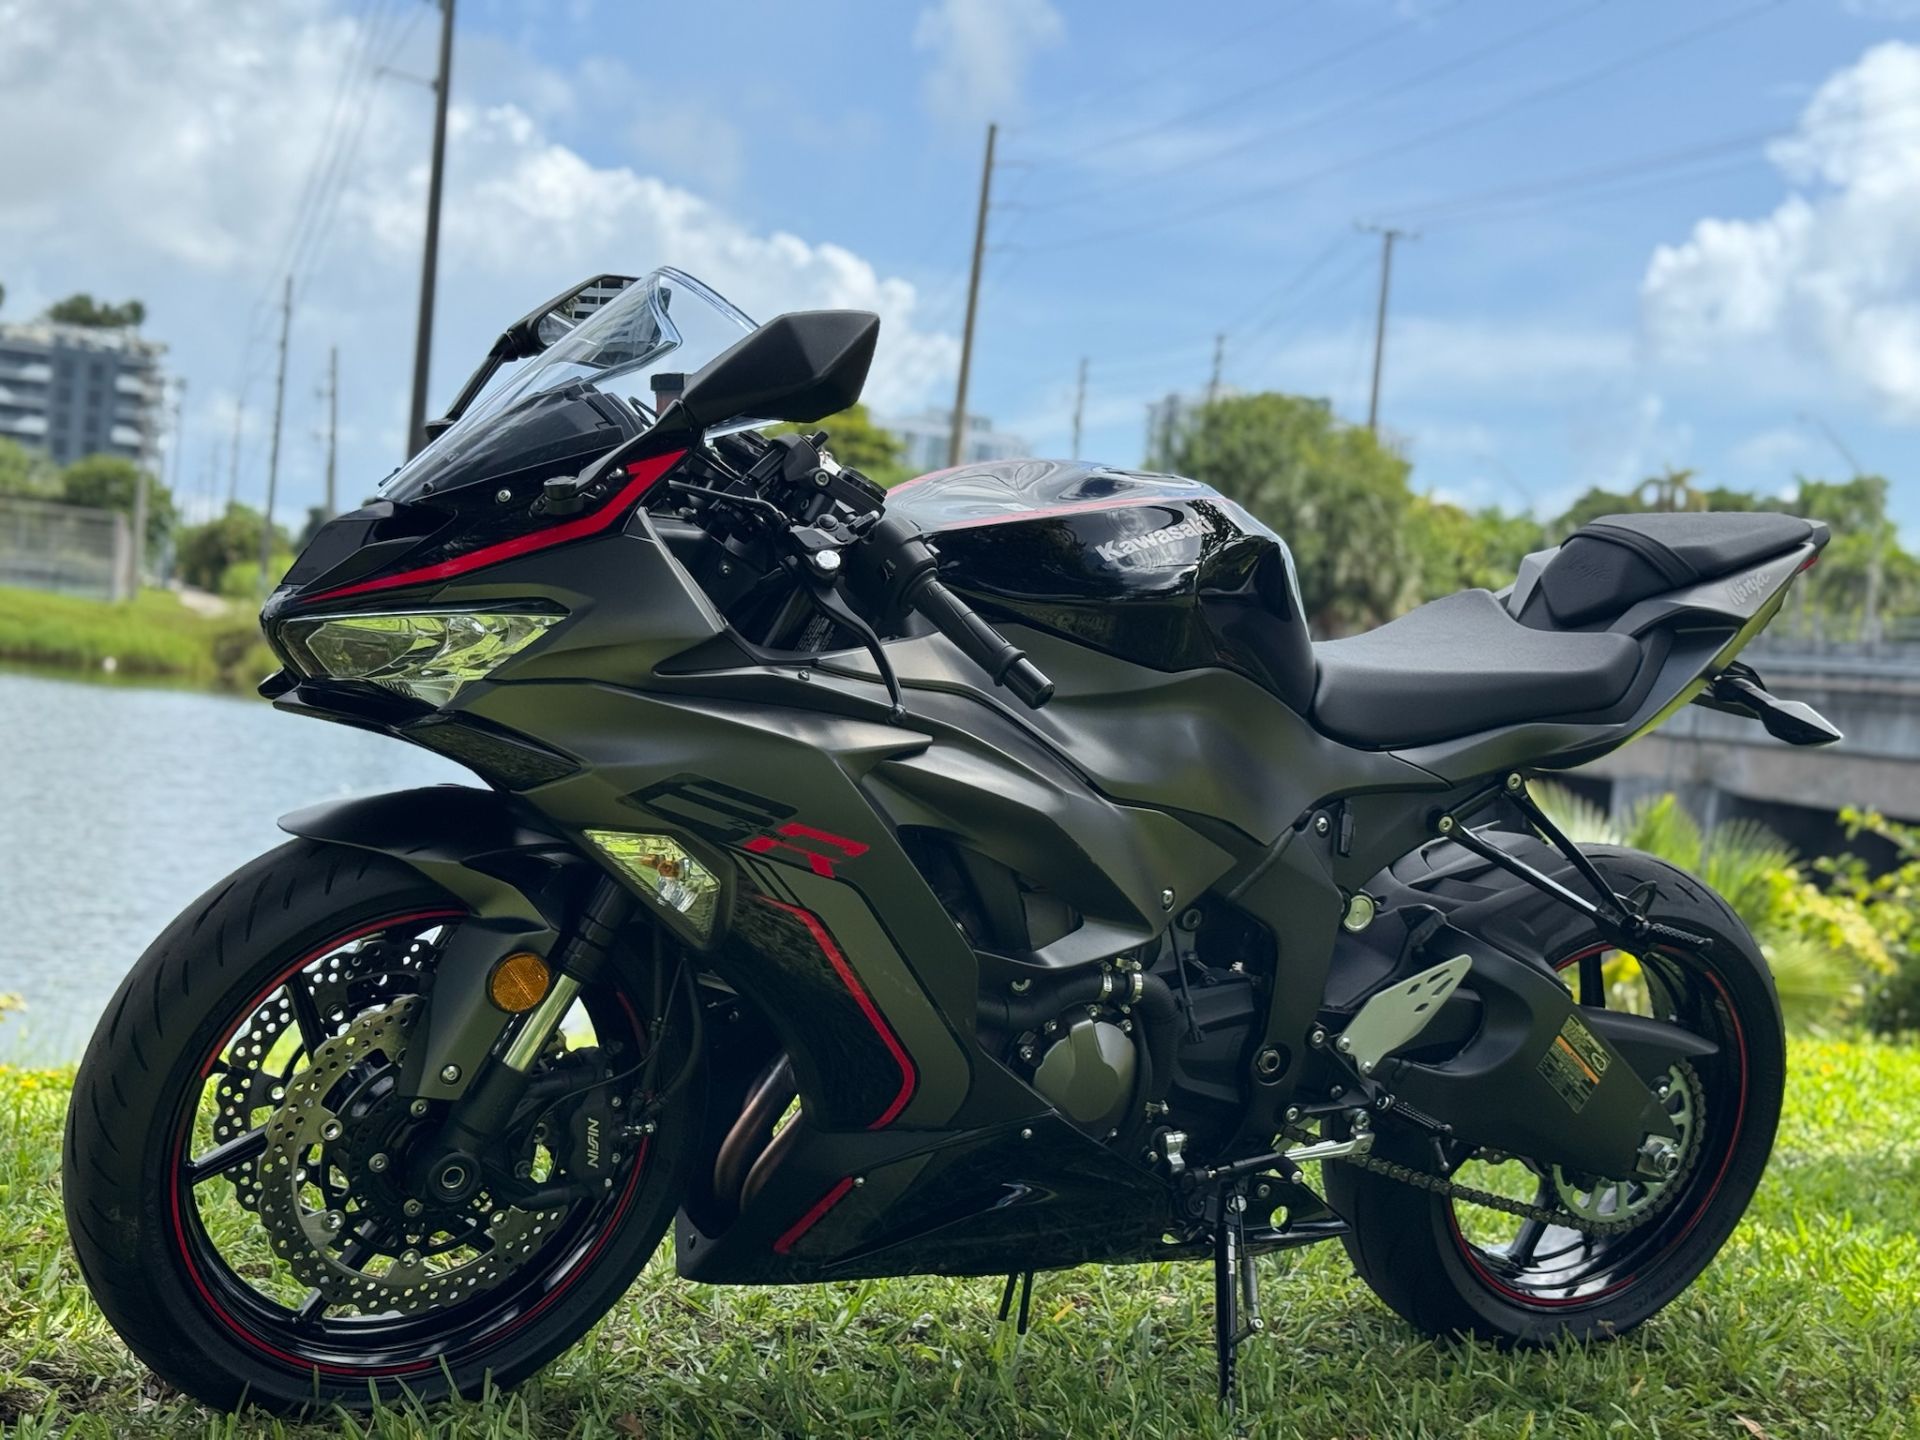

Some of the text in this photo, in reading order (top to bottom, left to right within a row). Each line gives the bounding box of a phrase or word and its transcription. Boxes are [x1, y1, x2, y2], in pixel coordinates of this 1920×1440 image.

[1095, 516, 1216, 562] Kawasaki
[1727, 573, 1770, 606] Ninja
[587, 1117, 600, 1169] NISSIN
